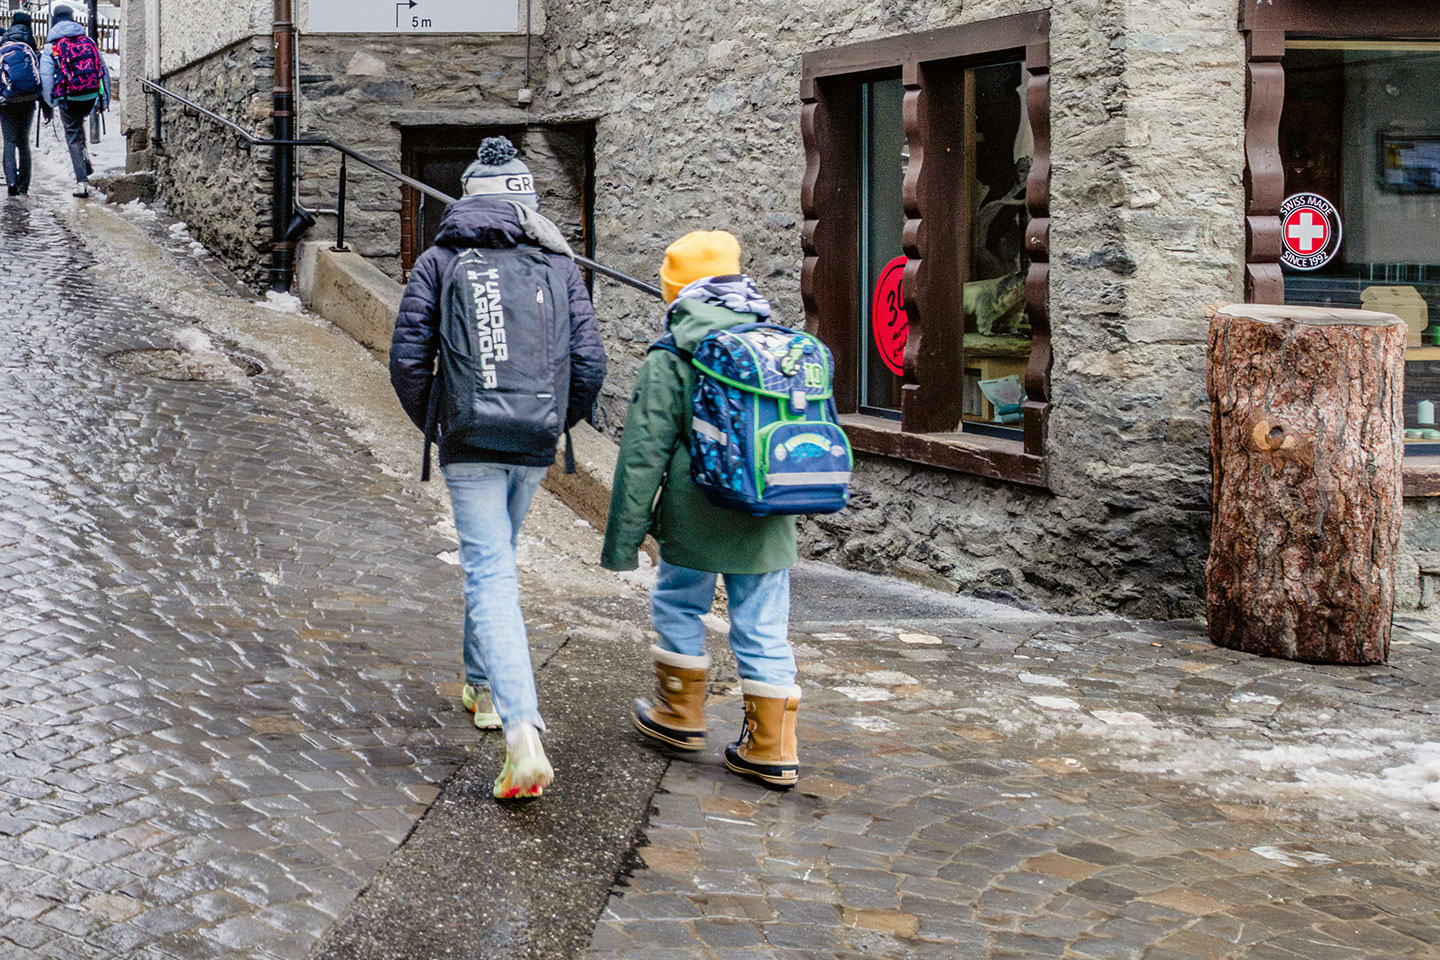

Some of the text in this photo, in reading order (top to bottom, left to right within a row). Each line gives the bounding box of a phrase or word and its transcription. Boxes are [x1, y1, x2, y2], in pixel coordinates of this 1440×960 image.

[1280, 196, 1333, 216] SWISS MADE
[1282, 250, 1329, 268] SINCE 1992
[471, 282, 498, 390] ARMOUR
[485, 280, 508, 362] UNDER
